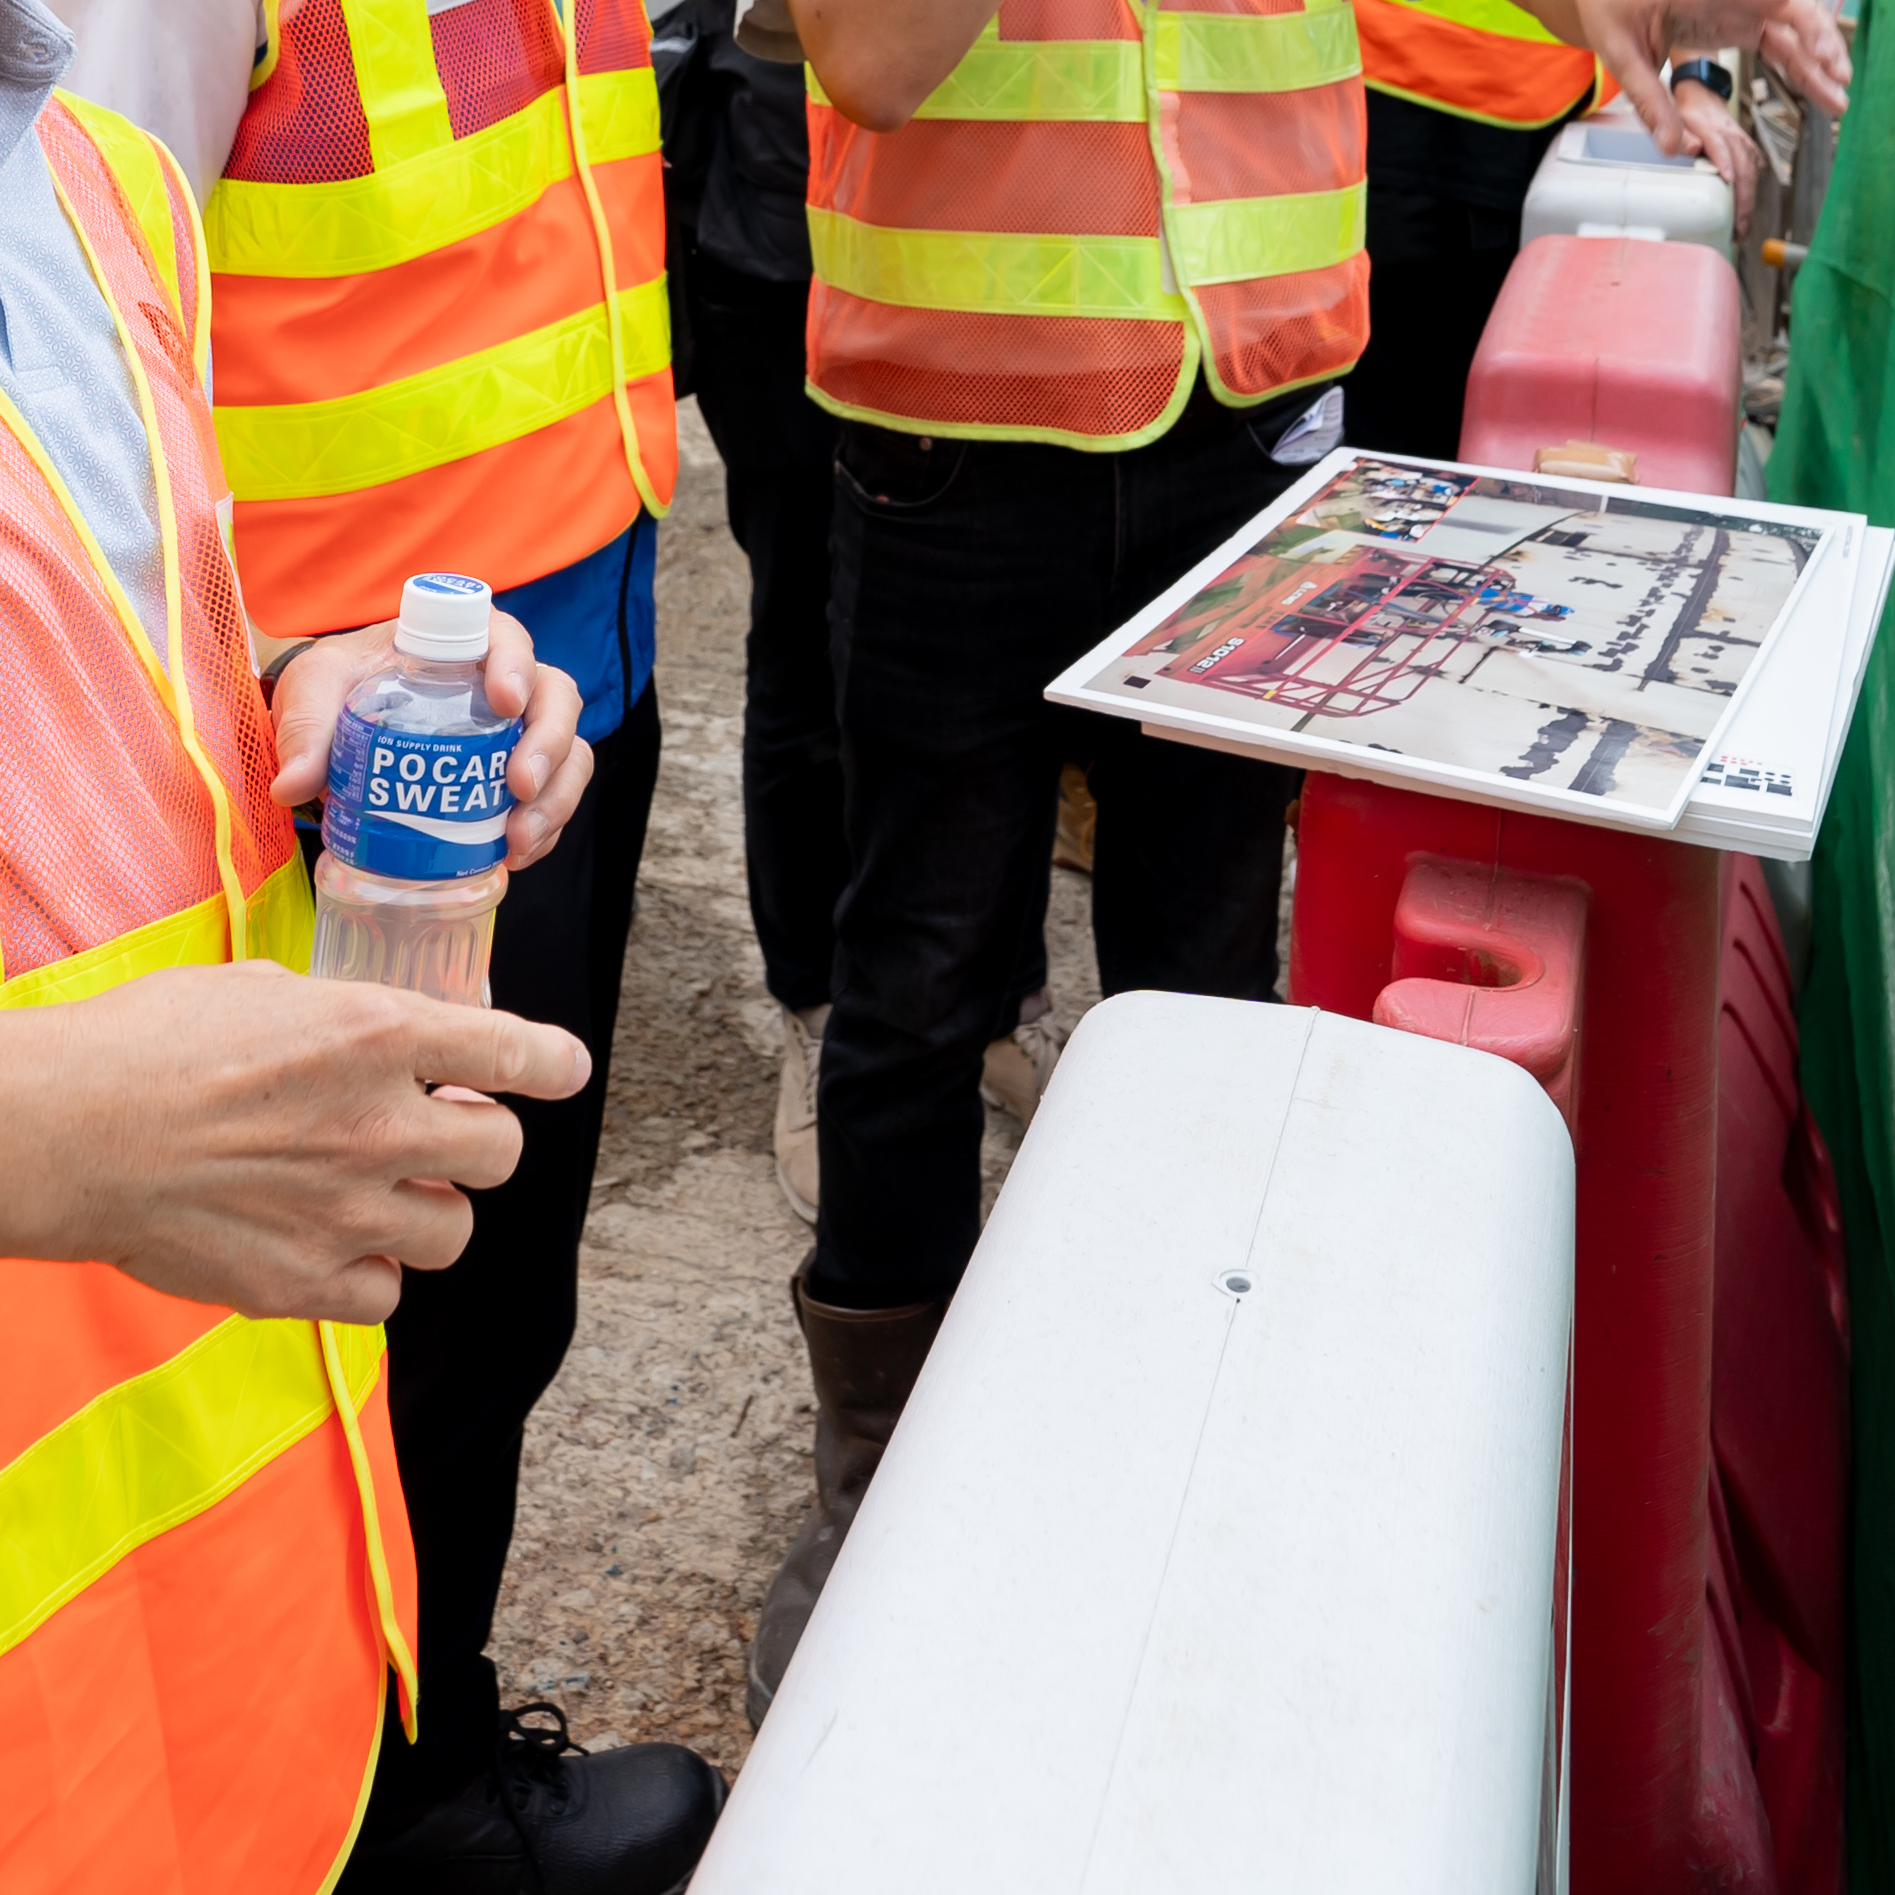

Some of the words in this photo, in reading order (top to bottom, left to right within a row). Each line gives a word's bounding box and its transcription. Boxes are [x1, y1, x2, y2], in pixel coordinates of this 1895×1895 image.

[377, 735, 393, 746] ION
[396, 740, 431, 752] SUPPLY
[432, 743, 463, 753] DRINK
[372, 746, 512, 785] POCAR
[368, 777, 506, 813] SWEAT
